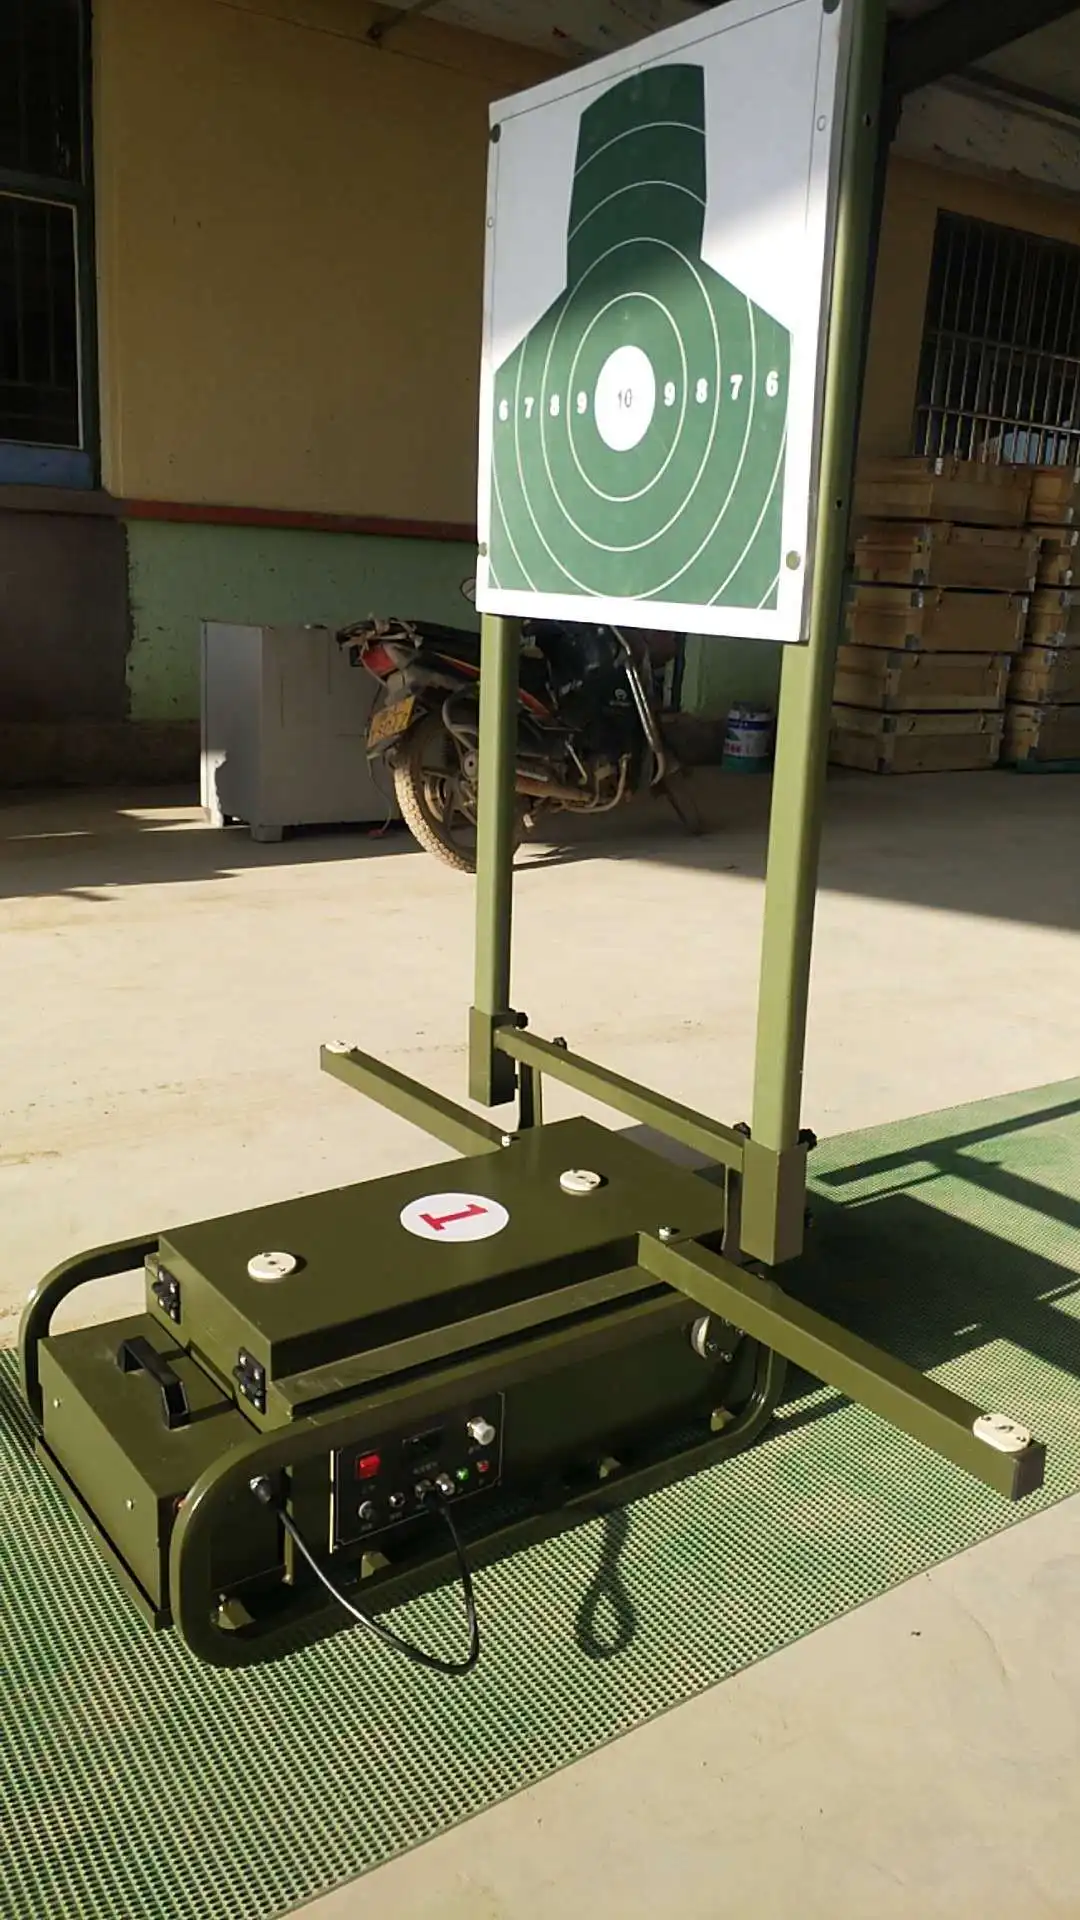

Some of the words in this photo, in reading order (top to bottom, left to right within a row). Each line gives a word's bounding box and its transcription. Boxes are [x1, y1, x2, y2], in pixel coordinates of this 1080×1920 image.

[498, 399, 509, 421] 6
[524, 396, 535, 419] 7
[549, 394, 560, 416] 8
[577, 391, 588, 414] 9
[618, 388, 633, 409] 10
[664, 382, 676, 406] 9
[696, 378, 708, 403] 8
[730, 374, 743, 400] 7
[765, 370, 779, 397] 6
[418, 1204, 488, 1231] 1
